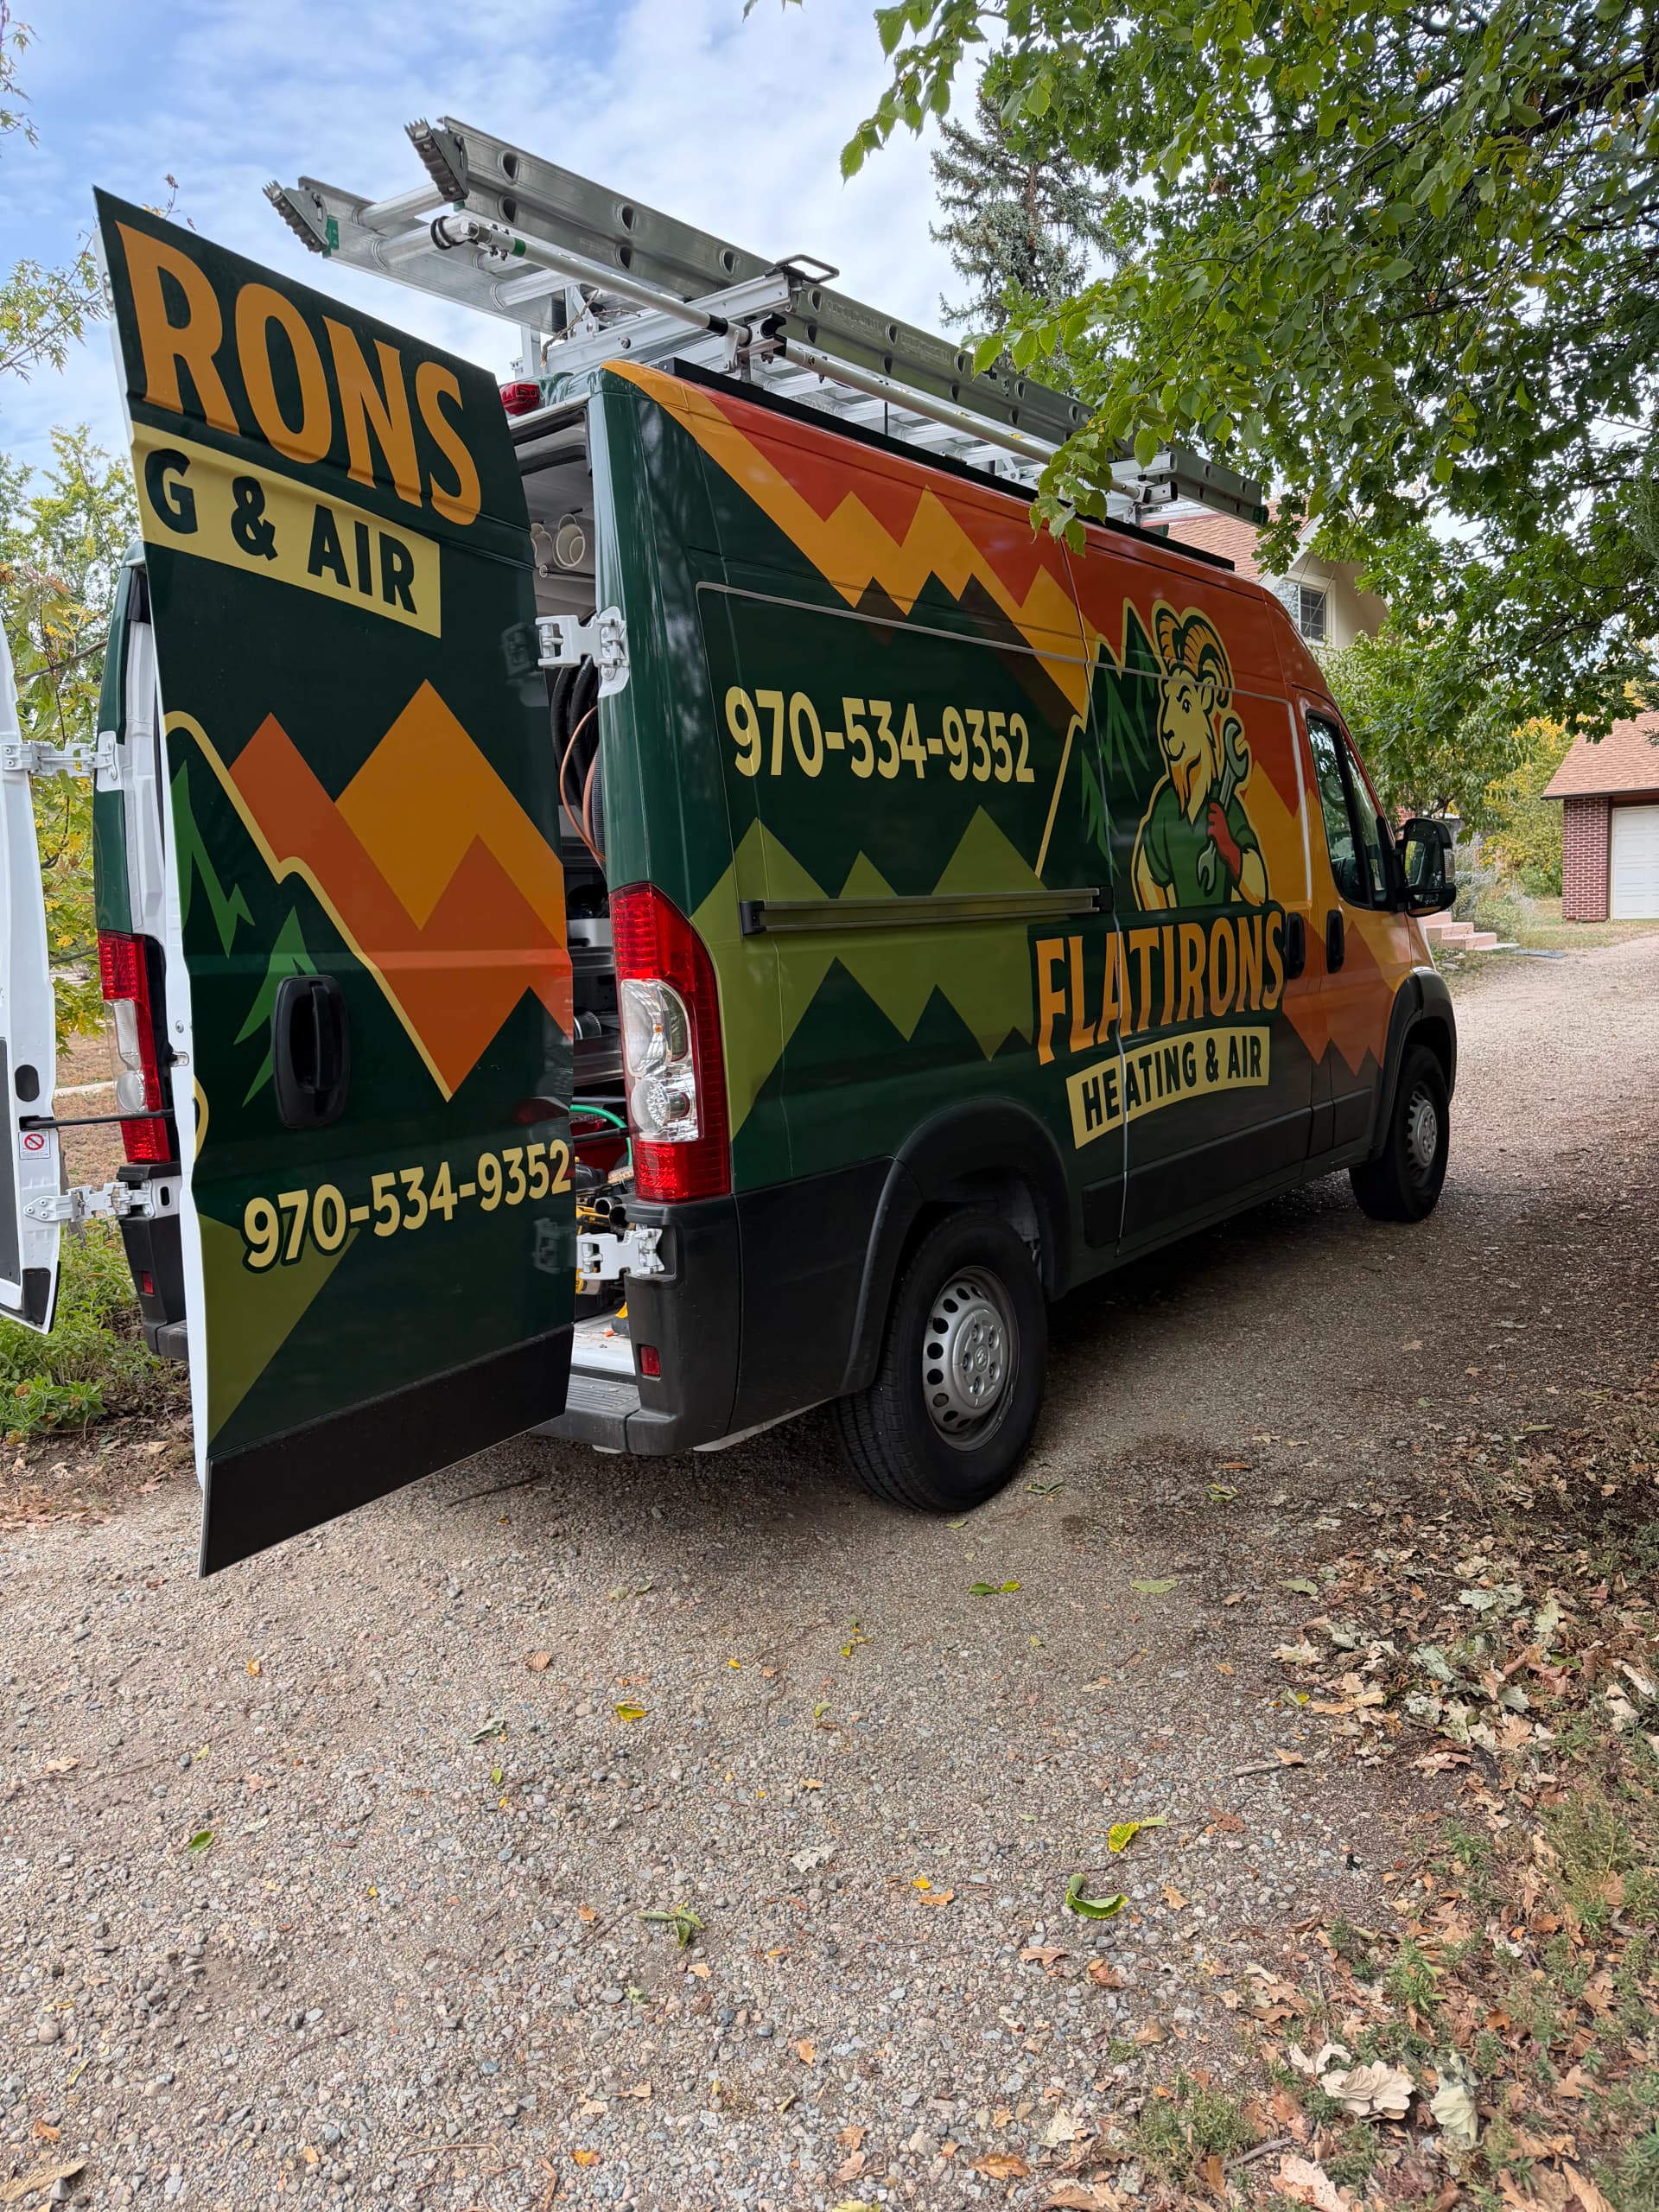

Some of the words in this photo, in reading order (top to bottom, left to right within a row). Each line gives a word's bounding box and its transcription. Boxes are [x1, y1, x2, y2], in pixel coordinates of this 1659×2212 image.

[115, 220, 480, 526] RONS
[144, 448, 198, 534] G
[232, 476, 277, 562] &
[308, 504, 417, 614] AIR
[725, 686, 1035, 783] 970-534-9352
[1035, 911, 1284, 1065] FLATIRONS
[1081, 1041, 1197, 1132] HEATING
[1205, 1037, 1219, 1083] &
[1227, 1035, 1262, 1079] AIR
[244, 1139, 571, 1268] 970-534-9352
